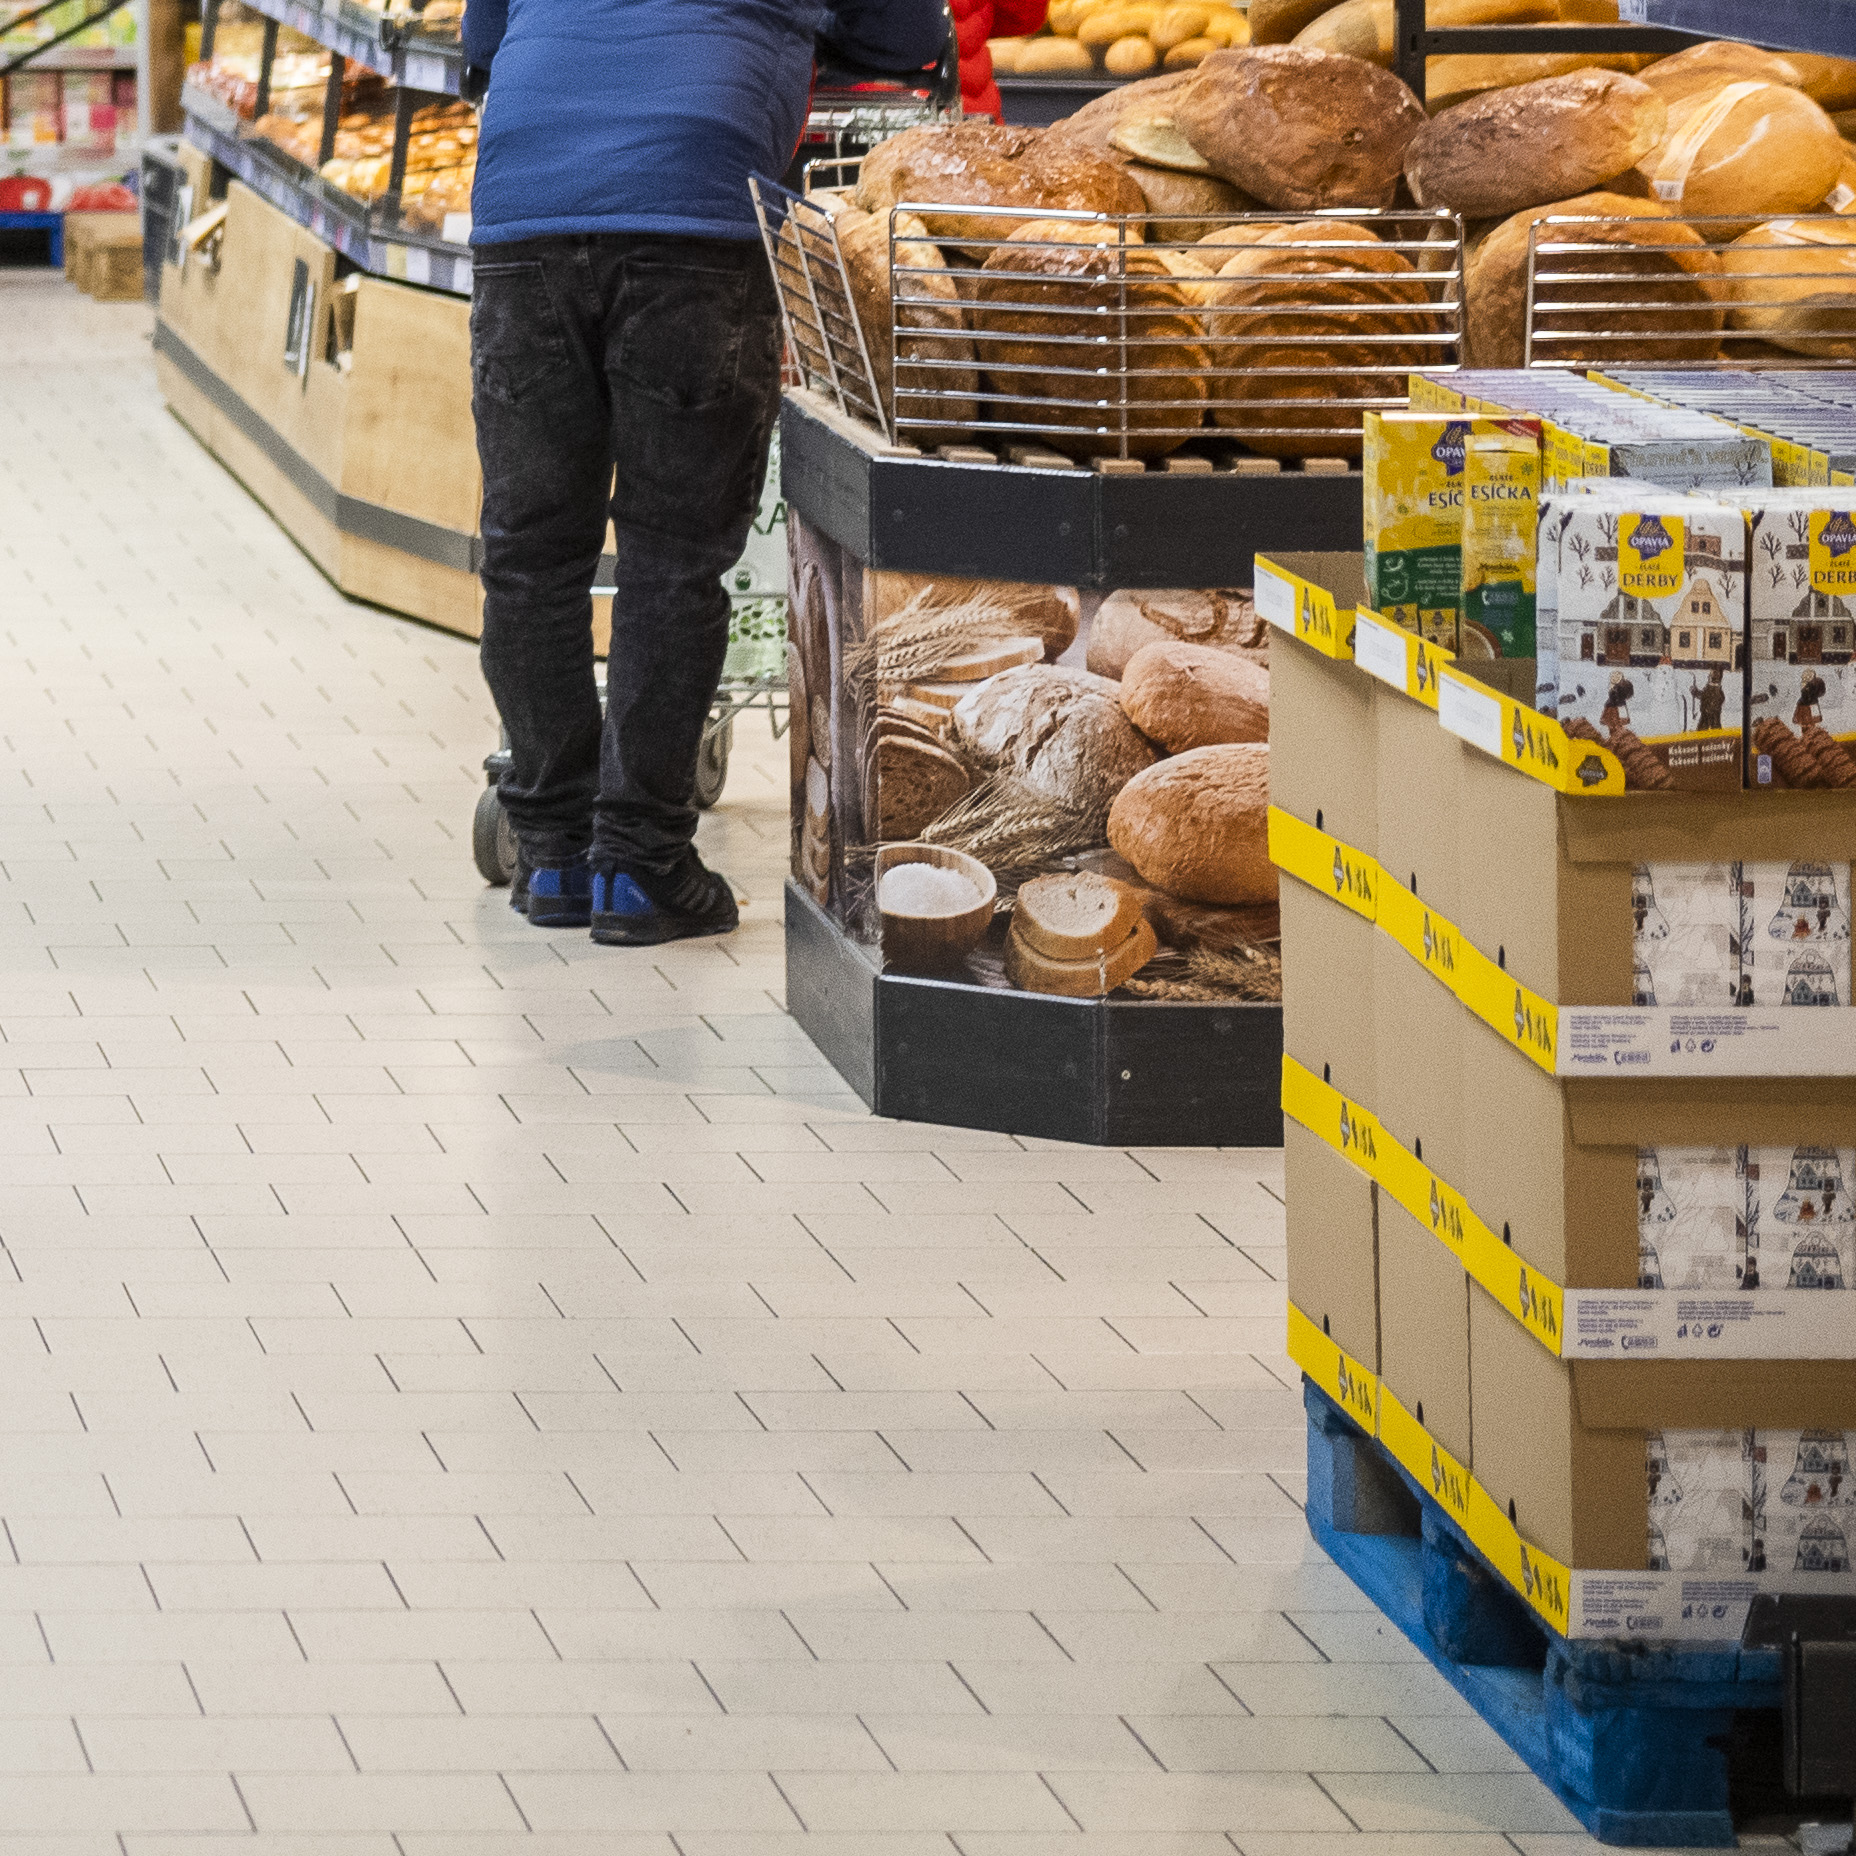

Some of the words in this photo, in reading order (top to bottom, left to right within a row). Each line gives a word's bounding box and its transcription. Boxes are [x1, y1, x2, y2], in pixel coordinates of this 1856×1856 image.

[1471, 478, 1532, 501] ESÍČKA
[1630, 535, 1669, 547] OPAVIA
[1622, 573, 1678, 588] DERBY
